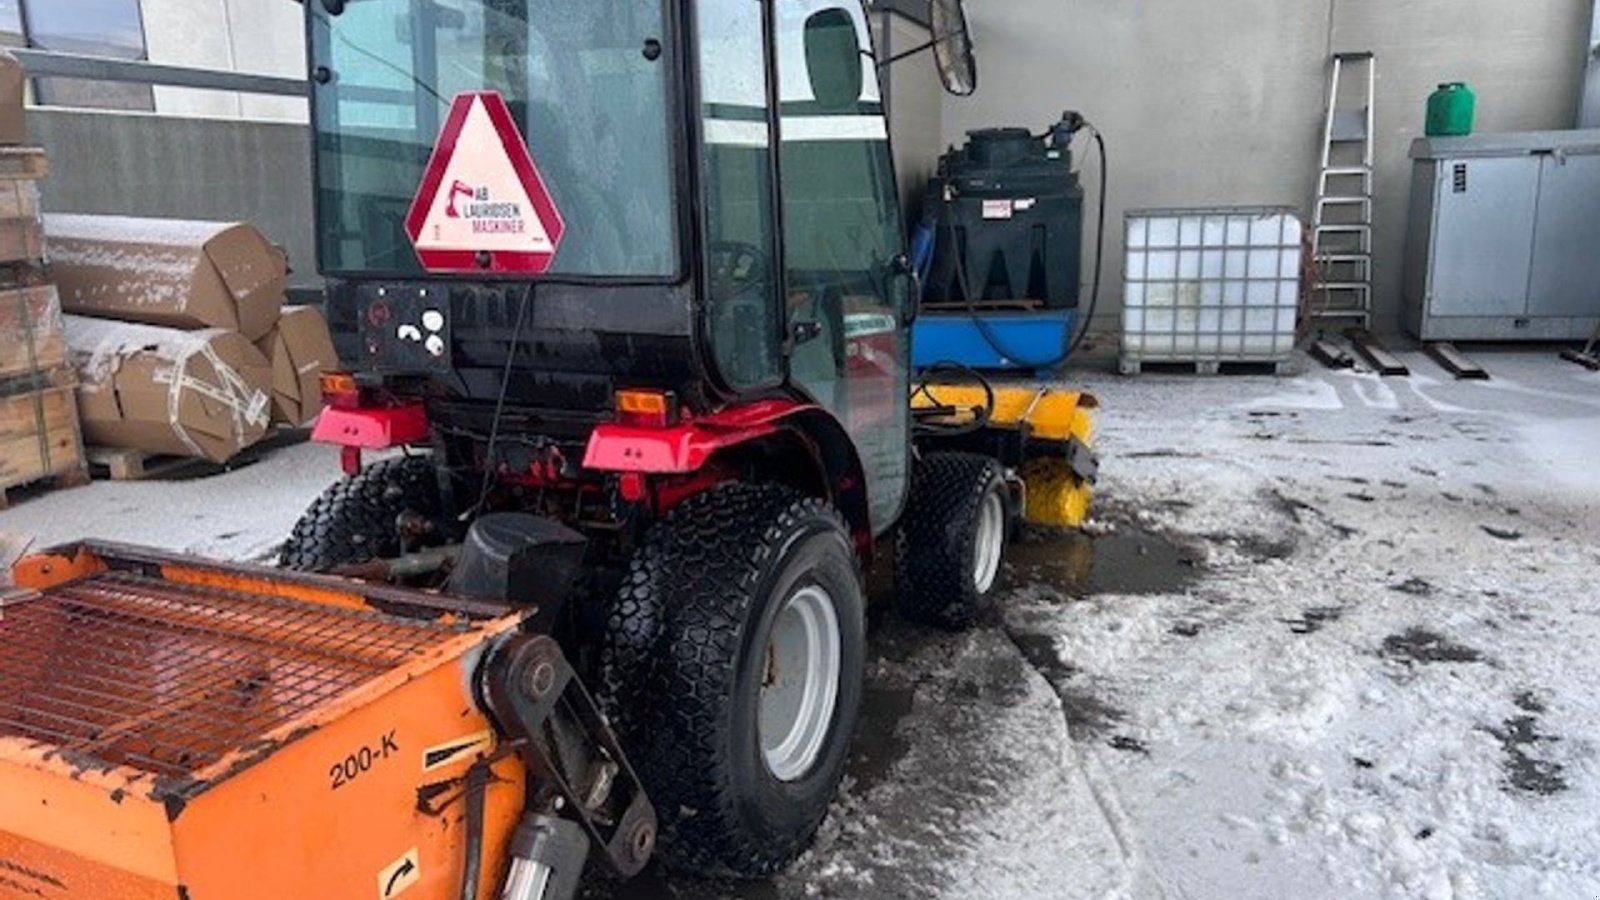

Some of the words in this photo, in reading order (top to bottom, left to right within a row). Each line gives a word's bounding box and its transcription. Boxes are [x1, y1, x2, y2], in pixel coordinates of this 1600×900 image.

[475, 186, 488, 201] AB
[472, 219, 526, 234] MASKINER
[329, 729, 399, 790] 200-K
